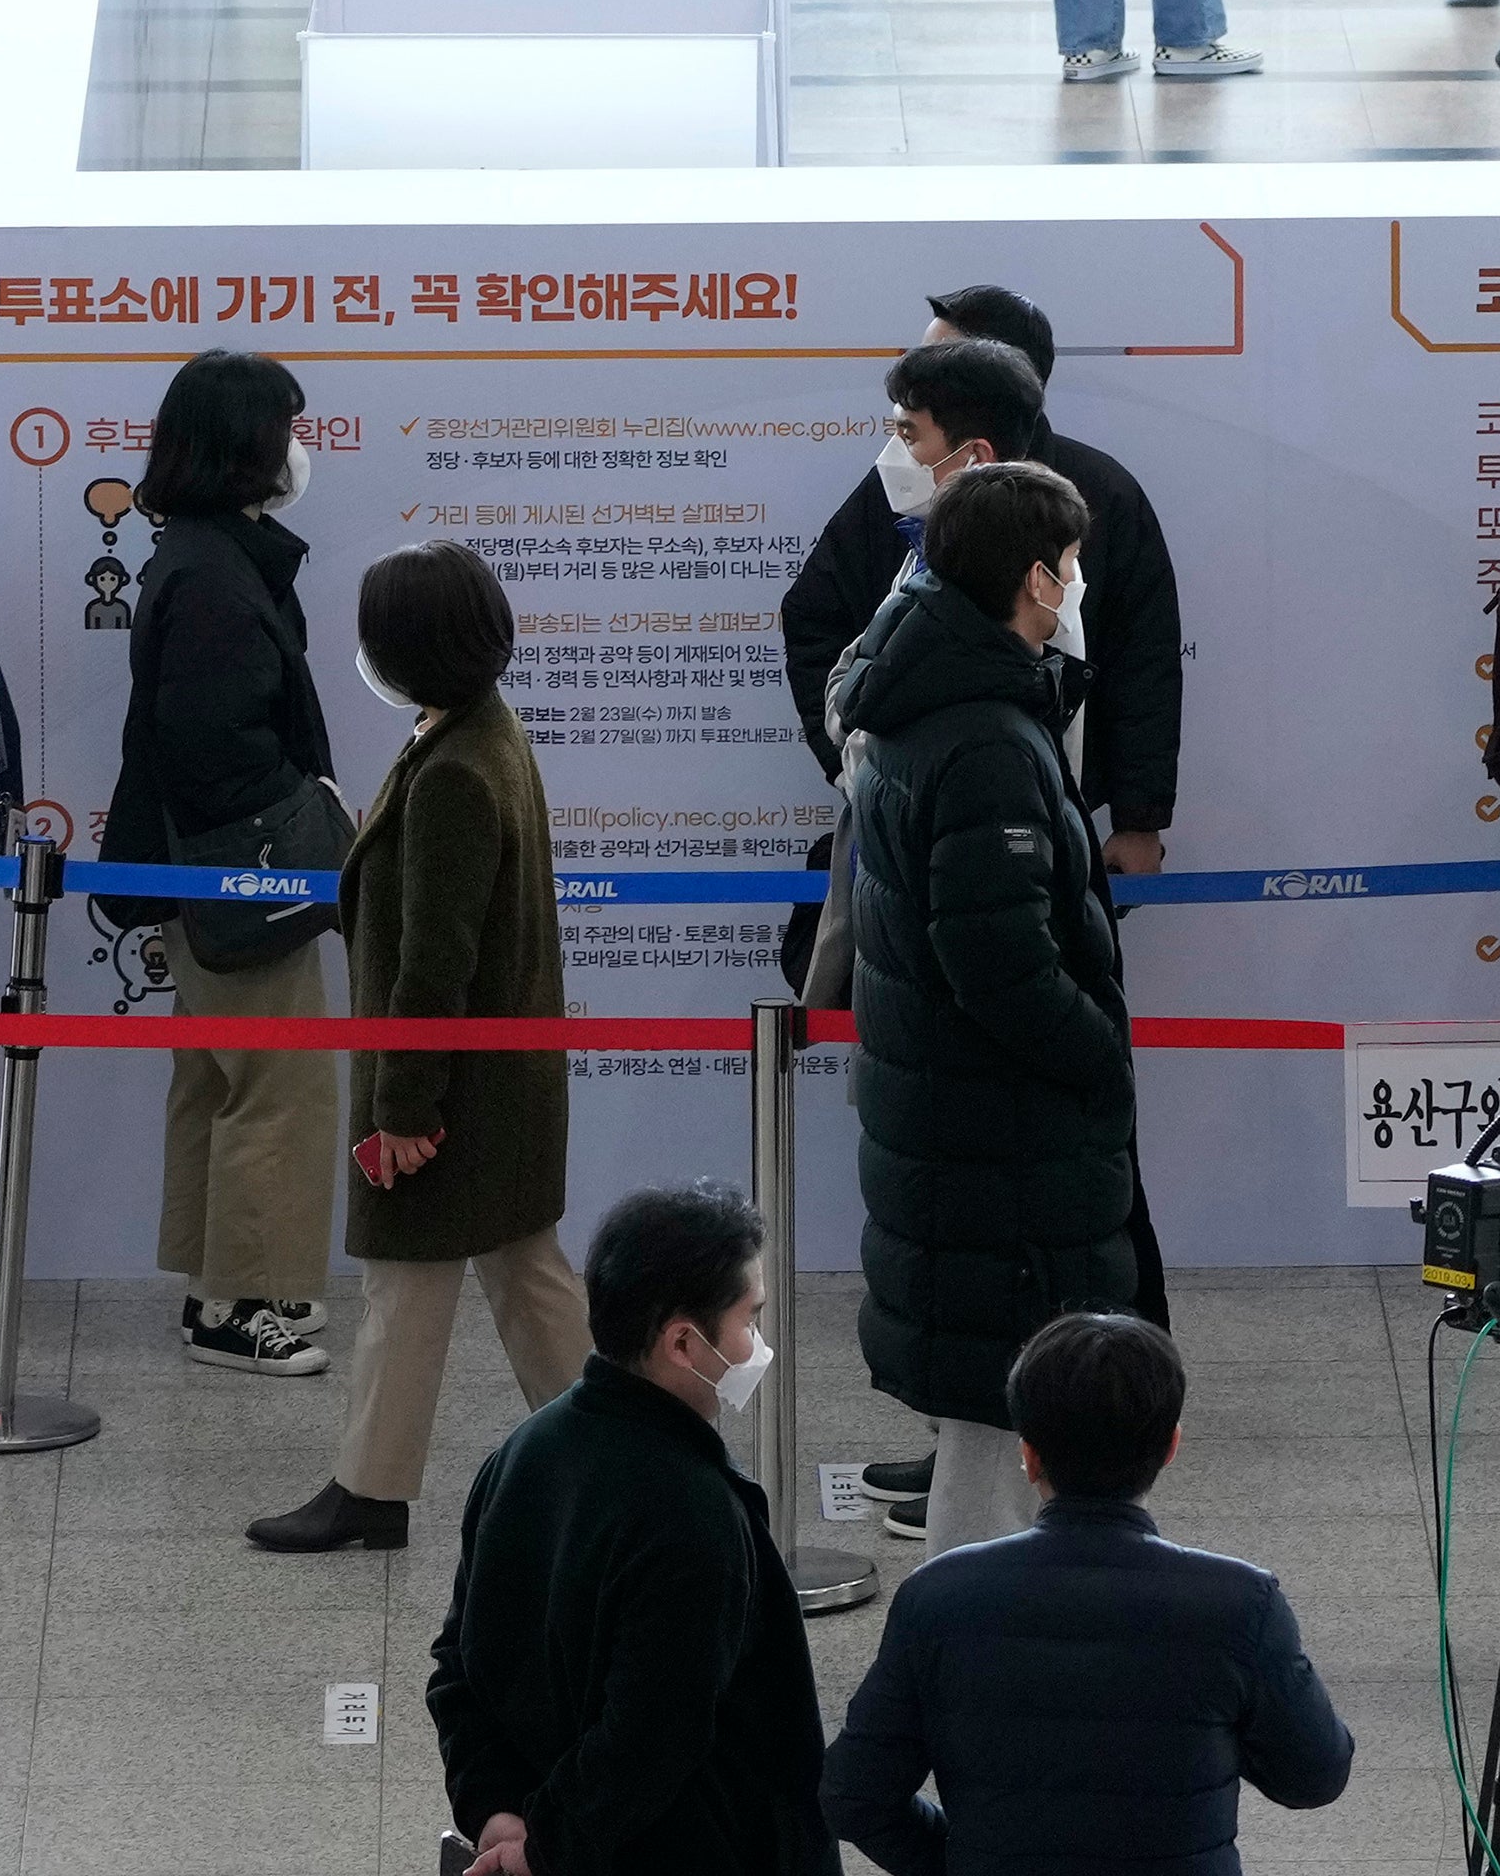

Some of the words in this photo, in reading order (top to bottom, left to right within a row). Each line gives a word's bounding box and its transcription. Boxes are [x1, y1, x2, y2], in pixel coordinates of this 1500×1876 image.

[217, 276, 314, 323] 가기
[333, 275, 396, 326] 전,
[411, 274, 460, 322] 꼭
[476, 273, 798, 322] 확인해주세요!
[85, 417, 156, 451] 후보
[426, 416, 617, 441] 중앙선거관리위원회
[624, 415, 877, 442] 누리집(www.nec.go.kr)
[426, 450, 461, 470] 정당
[472, 450, 522, 469] 후보자
[527, 450, 560, 469] 등에
[564, 450, 597, 469] 대한
[602, 449, 652, 469] 정확한
[656, 449, 690, 468] 정보
[694, 449, 727, 468] 확인
[427, 505, 469, 525] 거리
[475, 505, 516, 525] 등에
[522, 505, 585, 525] 게시된
[592, 504, 676, 524] 선거벽보
[682, 503, 767, 524] 살펴보기
[465, 537, 571, 558] 정당명(무소속
[575, 537, 644, 557] 후보자는
[647, 537, 708, 557] 무소속),
[713, 537, 764, 556] 후보자
[767, 536, 805, 556] 사진,
[563, 560, 597, 580] 거리
[601, 560, 616, 579] 등
[621, 560, 653, 580] 많은
[659, 560, 726, 580] 사람들이
[731, 560, 779, 579] 다니는
[518, 613, 602, 634] 발송되는
[609, 613, 693, 634] 선거공보
[698, 612, 784, 633] 살펴보기
[544, 647, 595, 665] 정책과
[599, 646, 633, 665] 공약
[637, 646, 669, 665] 등이
[674, 646, 741, 665] 게재되어
[745, 646, 779, 665] 있는
[1180, 641, 1196, 660] 서
[546, 671, 578, 690] 경력
[582, 671, 597, 689] 등
[603, 671, 687, 690] 인적사항과
[691, 670, 724, 689] 재산
[728, 670, 745, 689] 및
[749, 670, 783, 689] 병역
[516, 707, 566, 723] 공보는
[569, 707, 597, 723] 2월
[599, 707, 663, 724] 23일(수)
[666, 707, 698, 723] 까지
[701, 707, 732, 723] 발송
[569, 730, 597, 745] 2월
[599, 729, 663, 746] 27일(일)
[666, 729, 697, 745] 까지
[700, 729, 794, 745] 투표안내문과
[550, 805, 789, 832] 리미(policy.nec.go.kr)
[793, 804, 835, 826] 방문
[599, 839, 651, 859] 공약과
[654, 839, 738, 859] 선거공보를
[741, 838, 809, 857] 확인하고
[220, 871, 312, 898] KORAIL
[554, 878, 618, 898] RAIL
[1261, 871, 1369, 898] KORAIL
[583, 925, 635, 943] 주관의
[638, 925, 671, 943] 대담
[684, 925, 735, 942] 토론회
[738, 925, 774, 942] 등을
[571, 950, 639, 968] 모바일로
[643, 949, 711, 968] 다시보기
[713, 948, 782, 968] 가능(유튜
[596, 1057, 665, 1075] 공개장소
[668, 1057, 701, 1075] 연설
[714, 1057, 747, 1075] 대담
[337, 1692, 368, 1735] 거리두기
